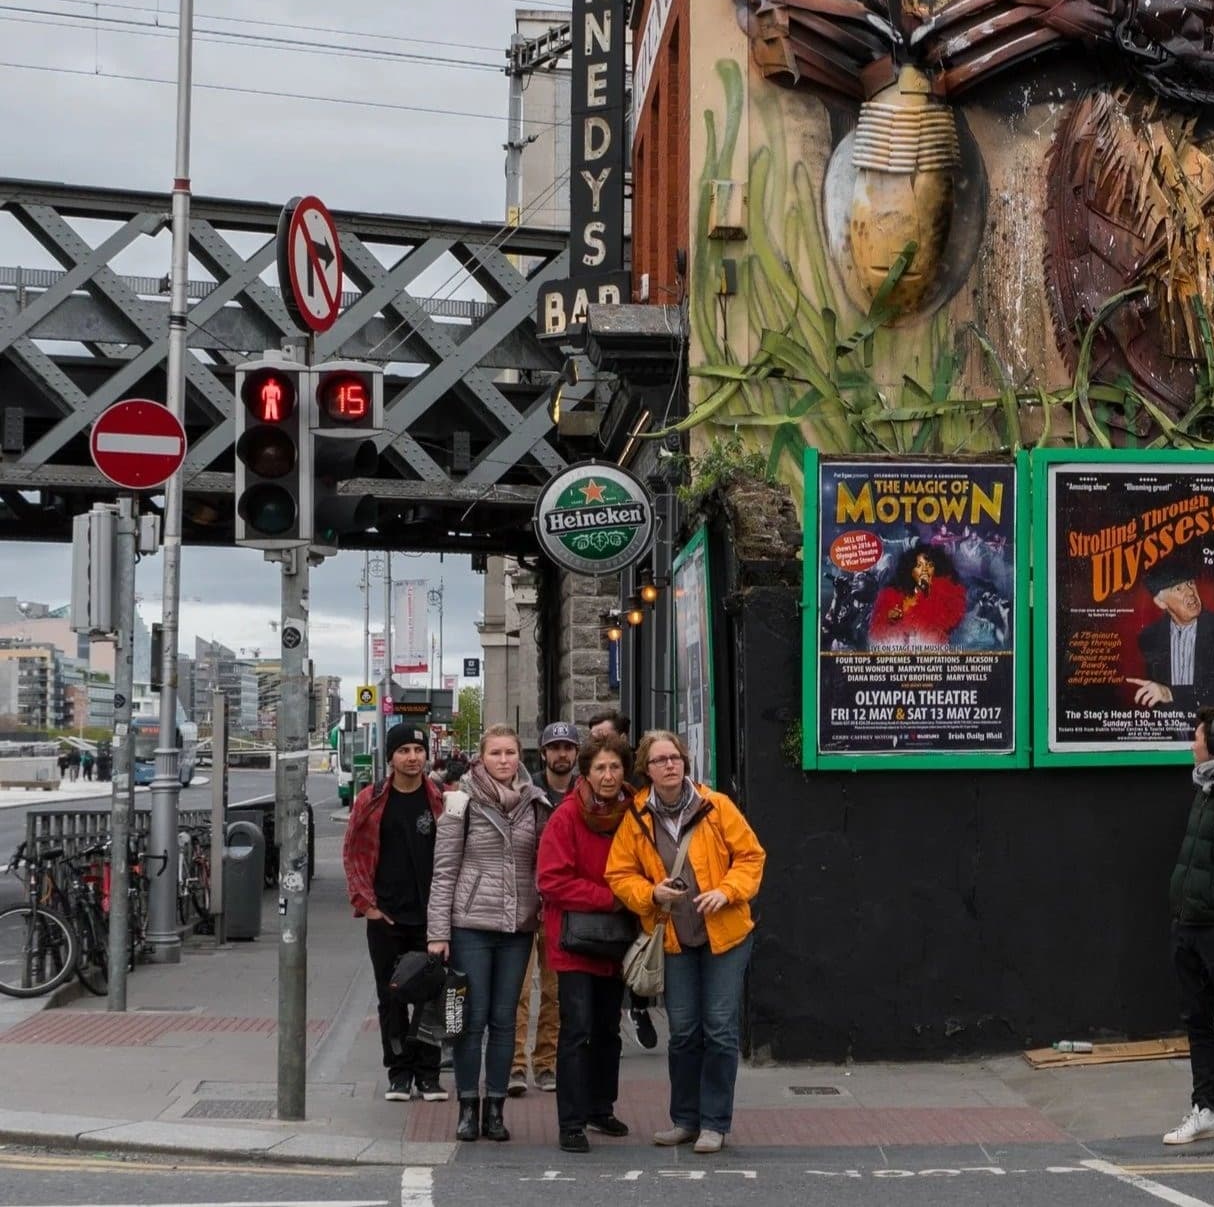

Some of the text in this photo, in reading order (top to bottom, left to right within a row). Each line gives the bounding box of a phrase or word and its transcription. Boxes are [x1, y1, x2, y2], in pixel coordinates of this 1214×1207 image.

[337, 385, 365, 415] 15
[873, 479, 970, 494] THE MAGIC OF
[835, 480, 1004, 525] MOTOWN
[548, 506, 643, 531] Heineken
[1069, 494, 1209, 557] Strolling Through
[856, 534, 867, 542] OUT
[835, 656, 999, 665] FOUR TOPS SUPREMES TEMPTATIONS JACKSON 5
[842, 665, 992, 673] STEVIE WONDER MARVYN GAYE LIONEL RICHIE
[847, 674, 988, 682] DIANA ROSS ISLEY BROTHERS MARY WELLS
[855, 690, 978, 706] OLYMPIA THEATRE
[831, 707, 1001, 721] FRI 12 MAY & SAT 13 MAY 2017
[1065, 710, 1186, 721] The Stag's Head Pub Theatre,
[1102, 720, 1133, 728] Sundays:
[948, 732, 965, 740] Irish
[966, 732, 985, 741] Daily
[986, 732, 1003, 740] Mail
[446, 988, 457, 1034] STOREHOUSE
[455, 995, 465, 1034] GUINNESS
